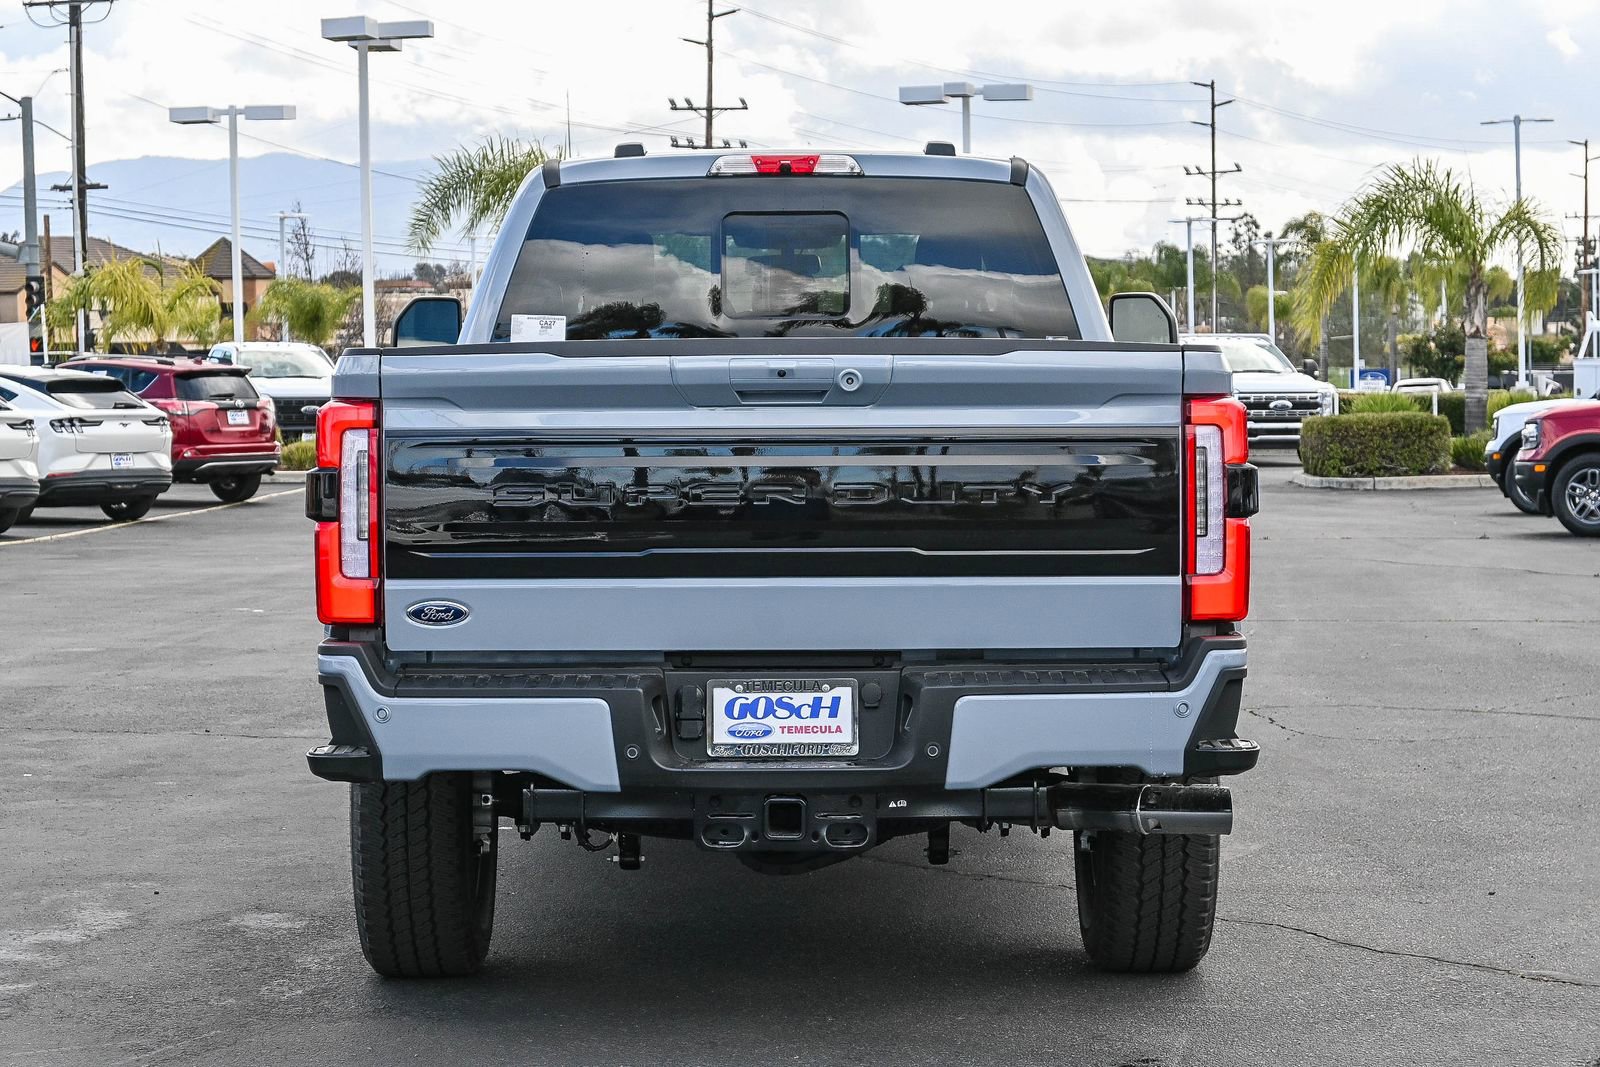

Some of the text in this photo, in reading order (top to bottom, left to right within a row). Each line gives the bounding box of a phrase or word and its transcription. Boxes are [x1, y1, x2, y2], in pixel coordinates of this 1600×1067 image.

[493, 482, 1073, 506] SUPER DUTY
[420, 605, 455, 620] Ford
[743, 680, 821, 692] TEMECULA
[735, 726, 843, 737] Ford TEMECULA
